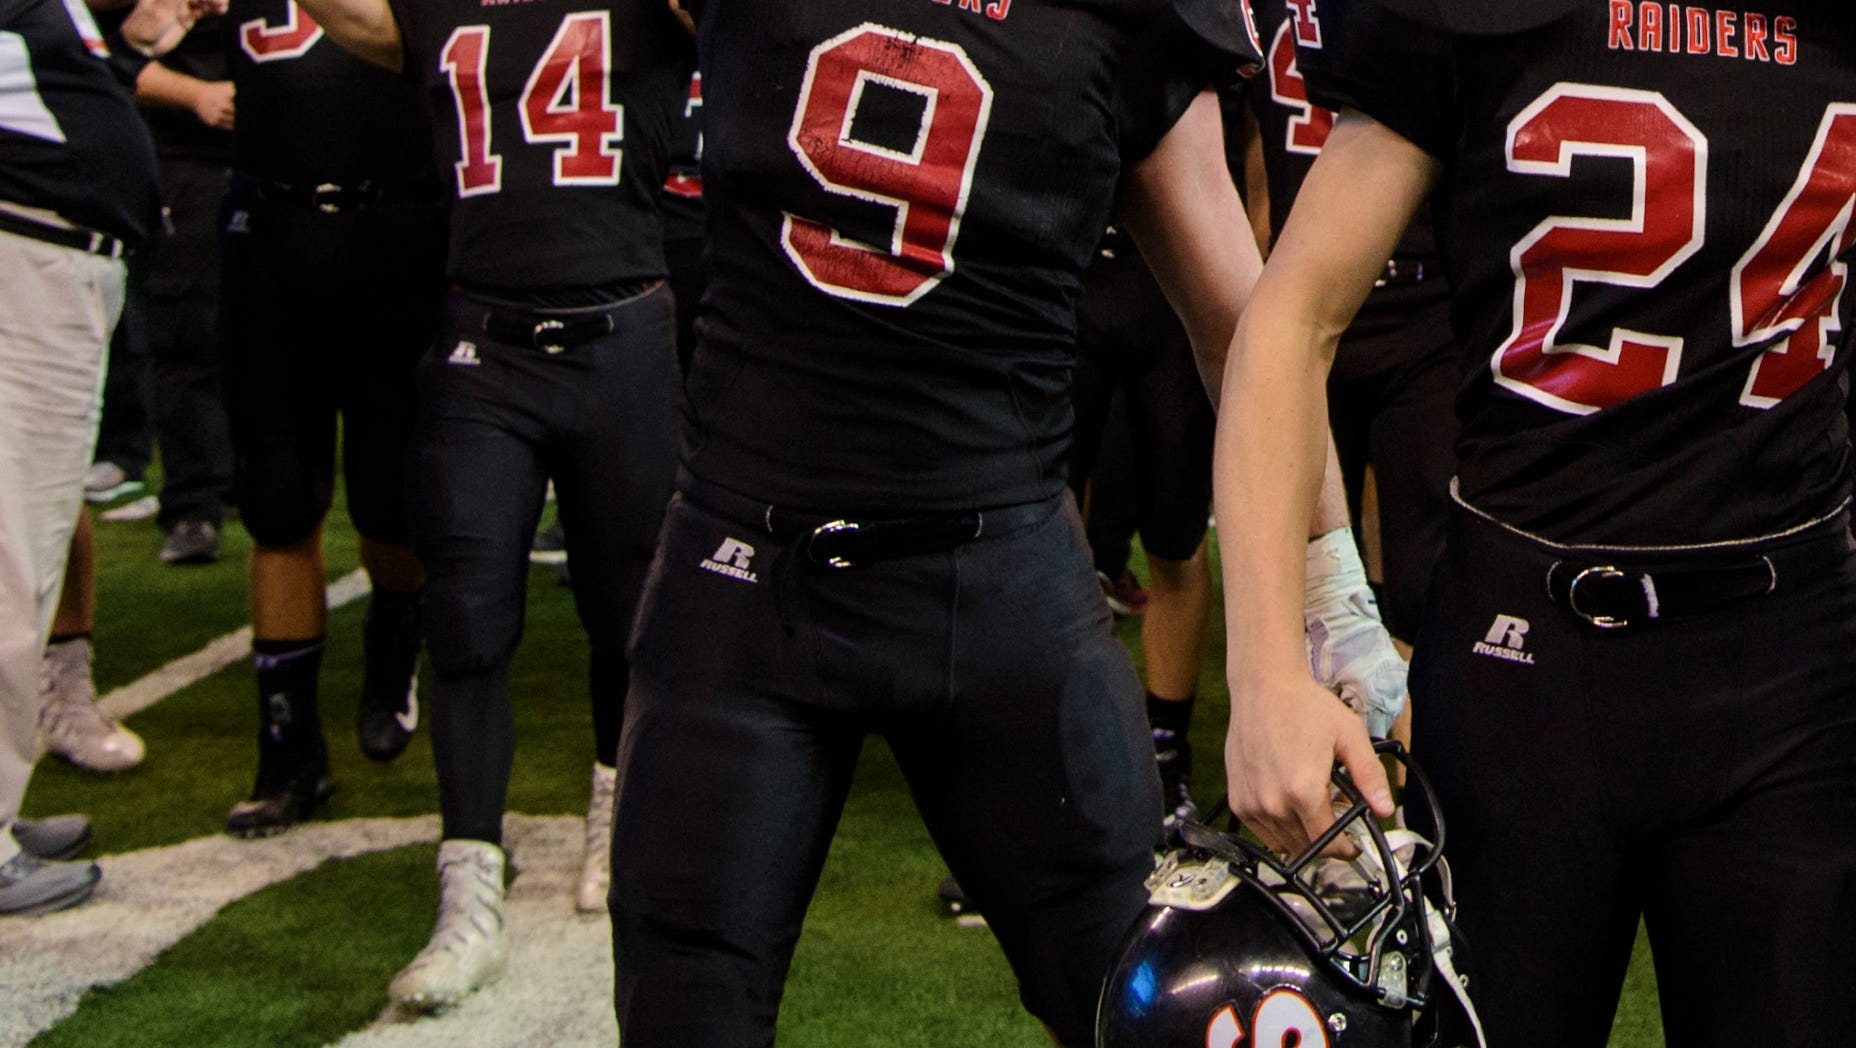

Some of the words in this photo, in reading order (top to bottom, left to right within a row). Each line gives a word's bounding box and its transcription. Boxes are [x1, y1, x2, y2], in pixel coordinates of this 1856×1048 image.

[439, 9, 624, 199] 14
[780, 21, 994, 307] 9
[700, 558, 758, 583] RUSSELL
[1473, 642, 1535, 665] RUSSELL
